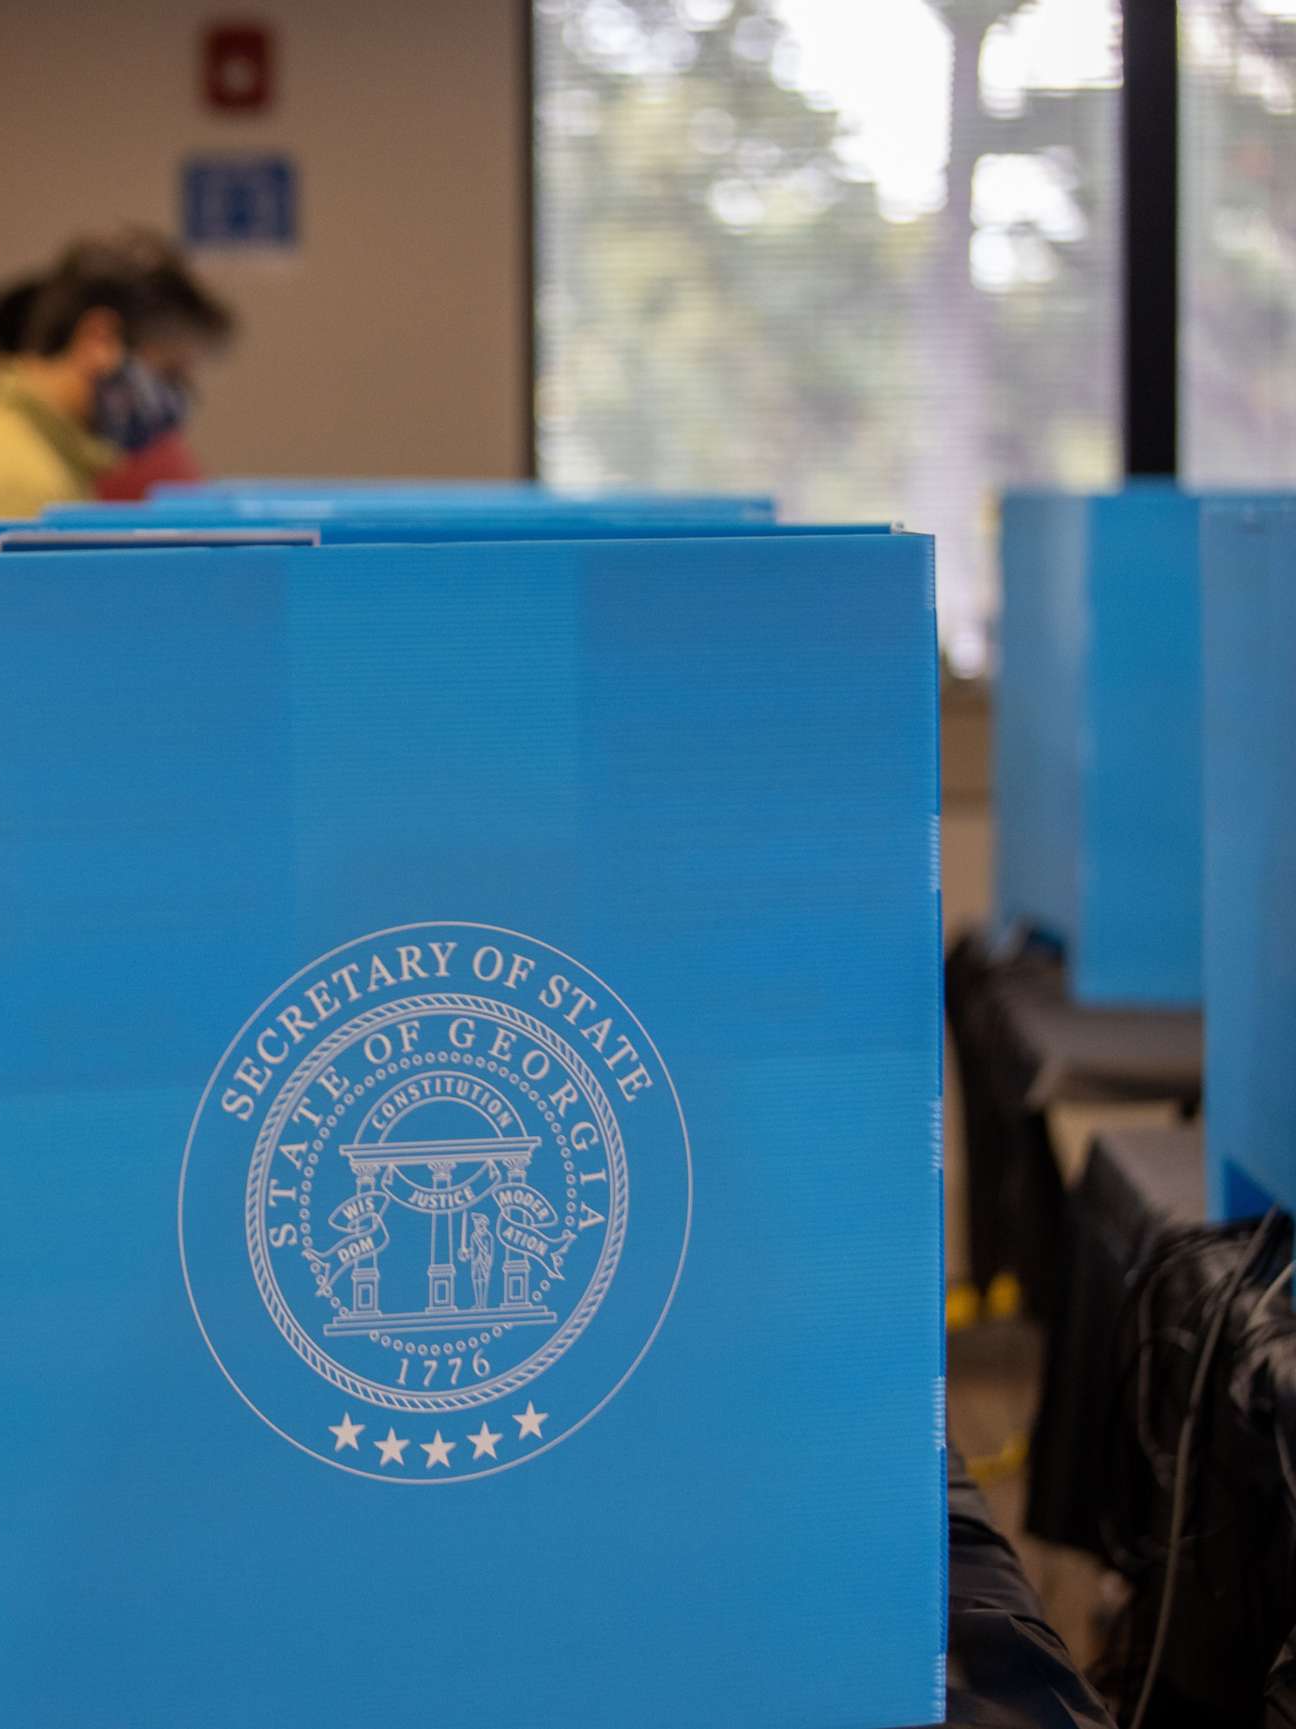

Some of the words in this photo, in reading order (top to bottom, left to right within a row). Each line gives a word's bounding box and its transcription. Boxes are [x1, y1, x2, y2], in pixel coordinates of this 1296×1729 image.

[221, 941, 456, 1121] SECRETARY
[472, 945, 536, 990] OF
[538, 975, 656, 1104] STATE
[372, 1080, 514, 1132] CONSTITUTION
[268, 1065, 350, 1248] STATE
[363, 1020, 422, 1062] OF
[449, 1018, 609, 1233] GEORGIA
[342, 1195, 375, 1220] WIS
[407, 1186, 475, 1207] JUSTICE
[499, 1189, 550, 1220] MODER
[338, 1238, 375, 1263] DOM
[504, 1226, 548, 1256] ATION
[395, 1350, 492, 1388] 1776
